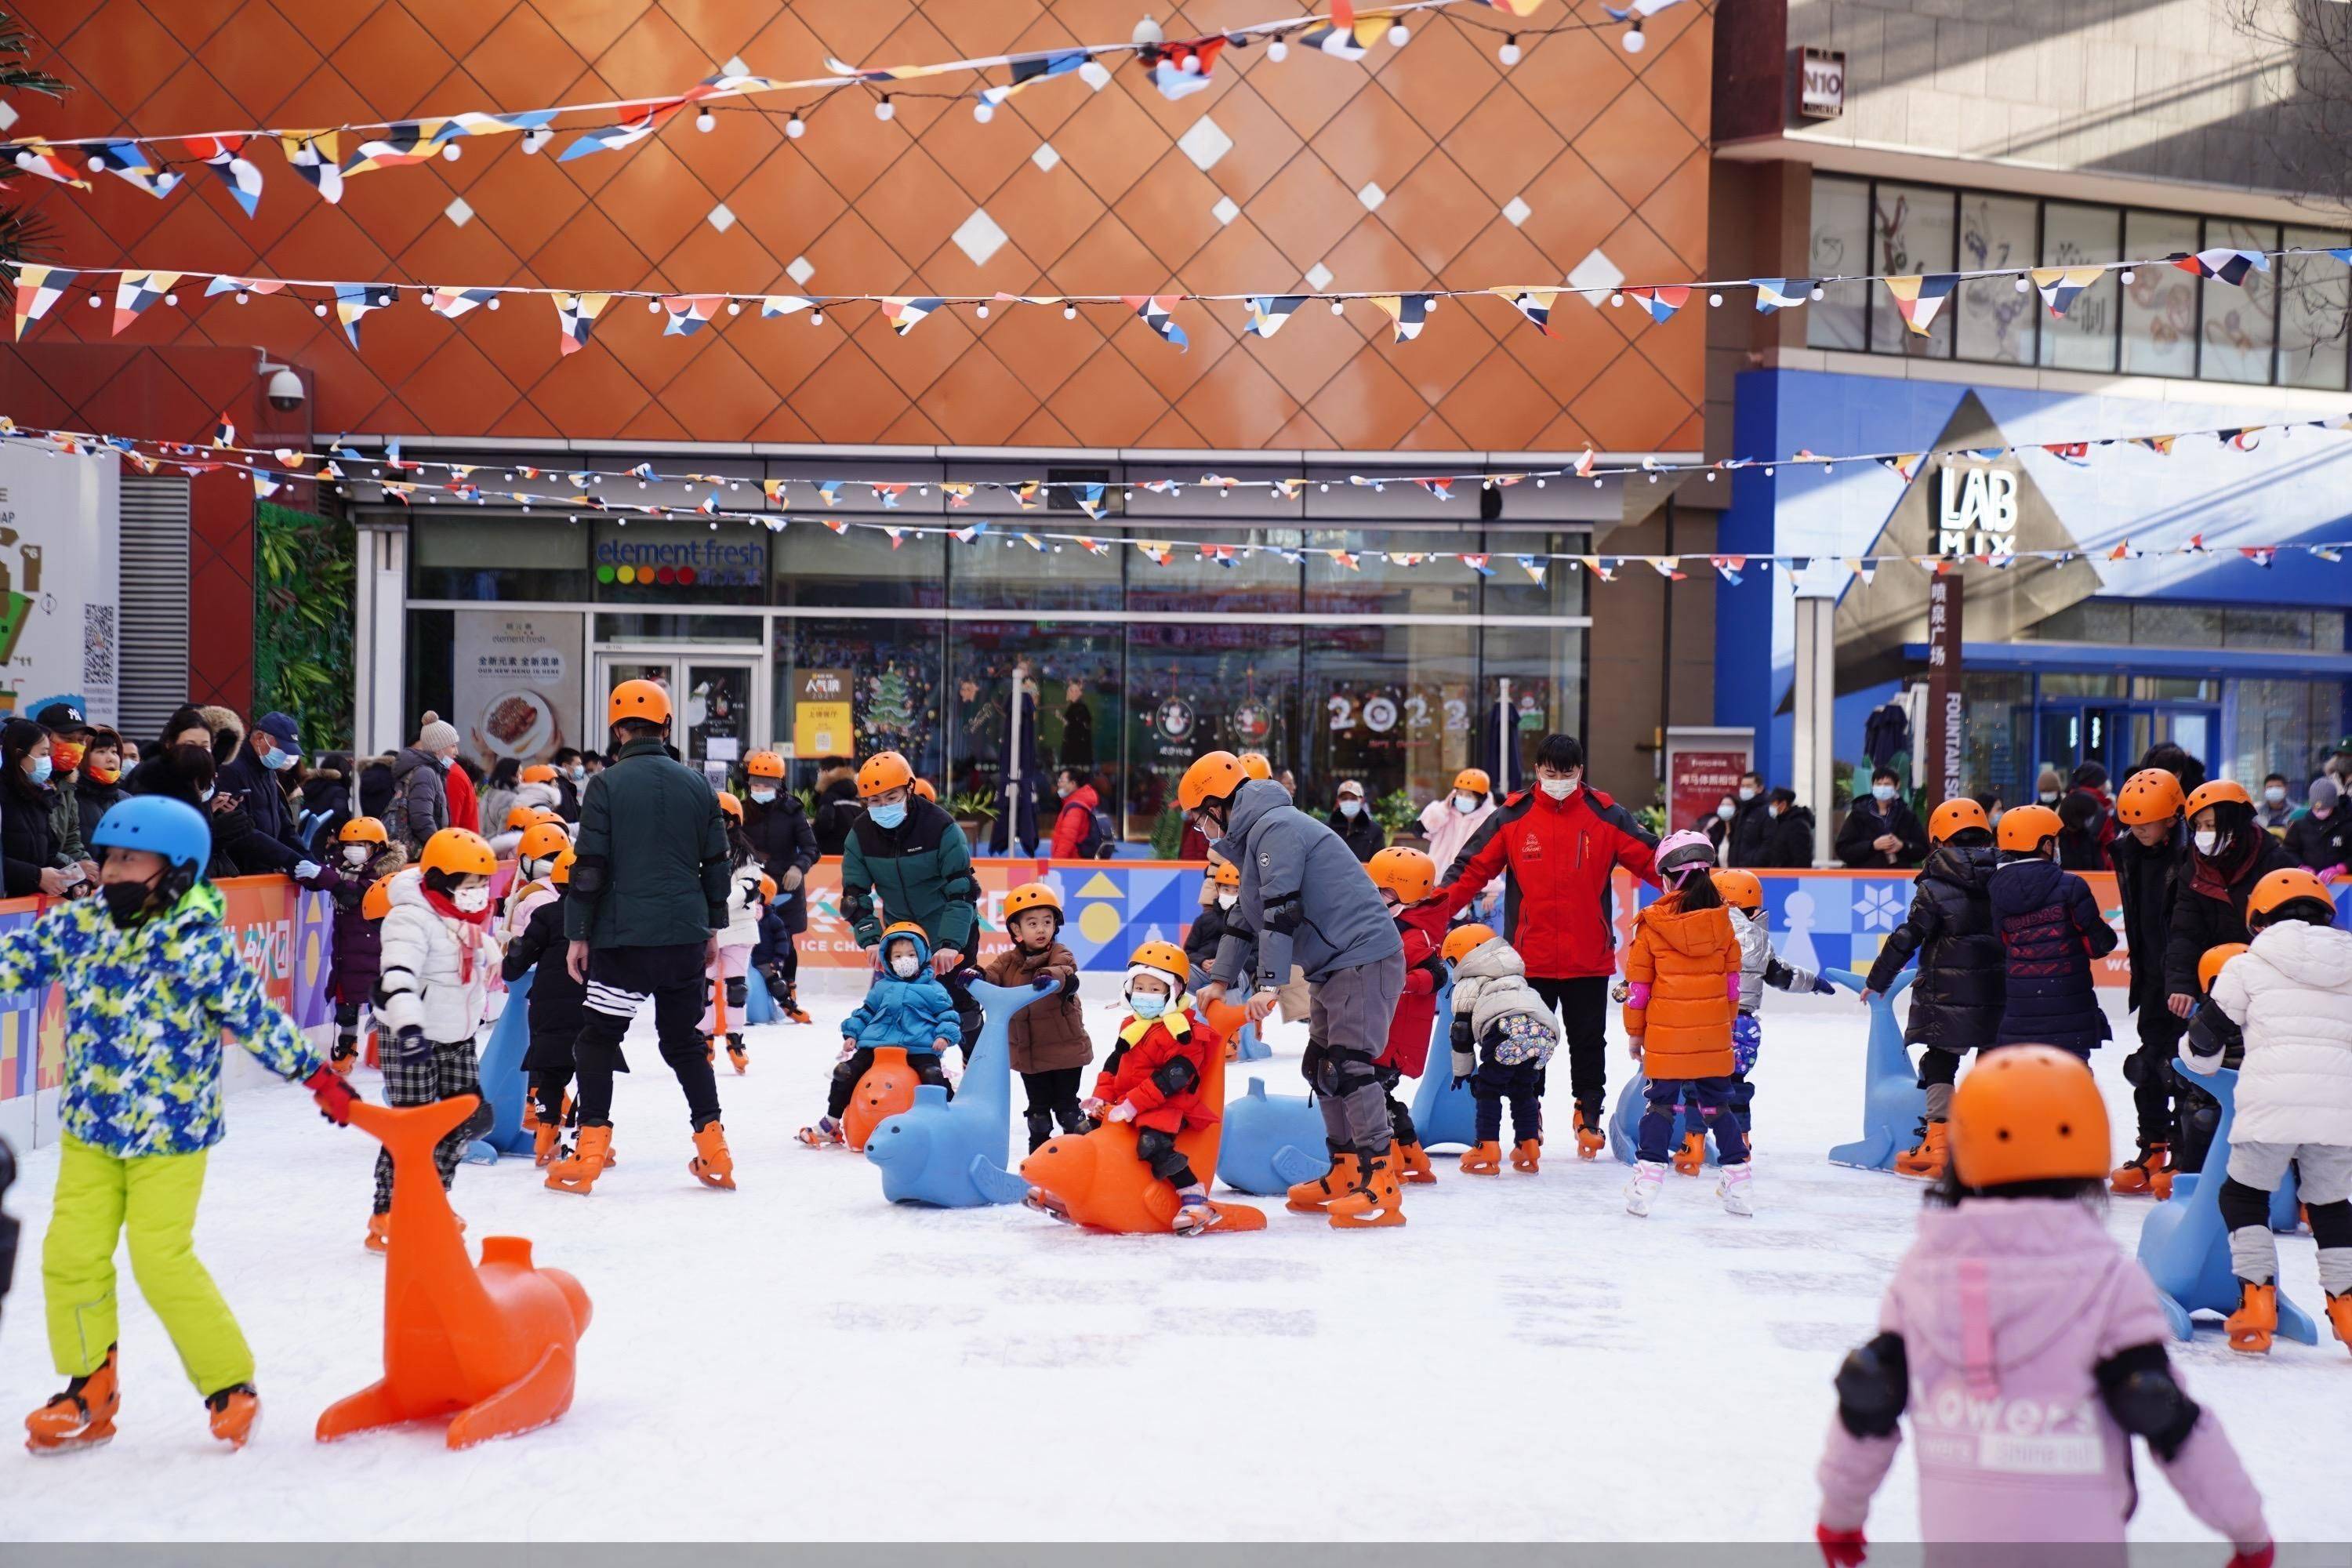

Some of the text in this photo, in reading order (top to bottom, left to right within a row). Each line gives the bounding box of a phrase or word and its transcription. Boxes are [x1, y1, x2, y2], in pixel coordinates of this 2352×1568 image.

[1803, 69, 1842, 95] N10
[1940, 466, 2018, 532] LAB
[597, 539, 764, 565] element fresh
[1940, 530, 2016, 556] MIX
[1929, 583, 1947, 666] 喷泉广场
[492, 635, 546, 644] element fresh
[478, 656, 517, 666] 全新元素
[1327, 694, 1471, 732] 2022
[1945, 691, 1962, 776] FOUNTAIN
[800, 940, 828, 952] ICE
